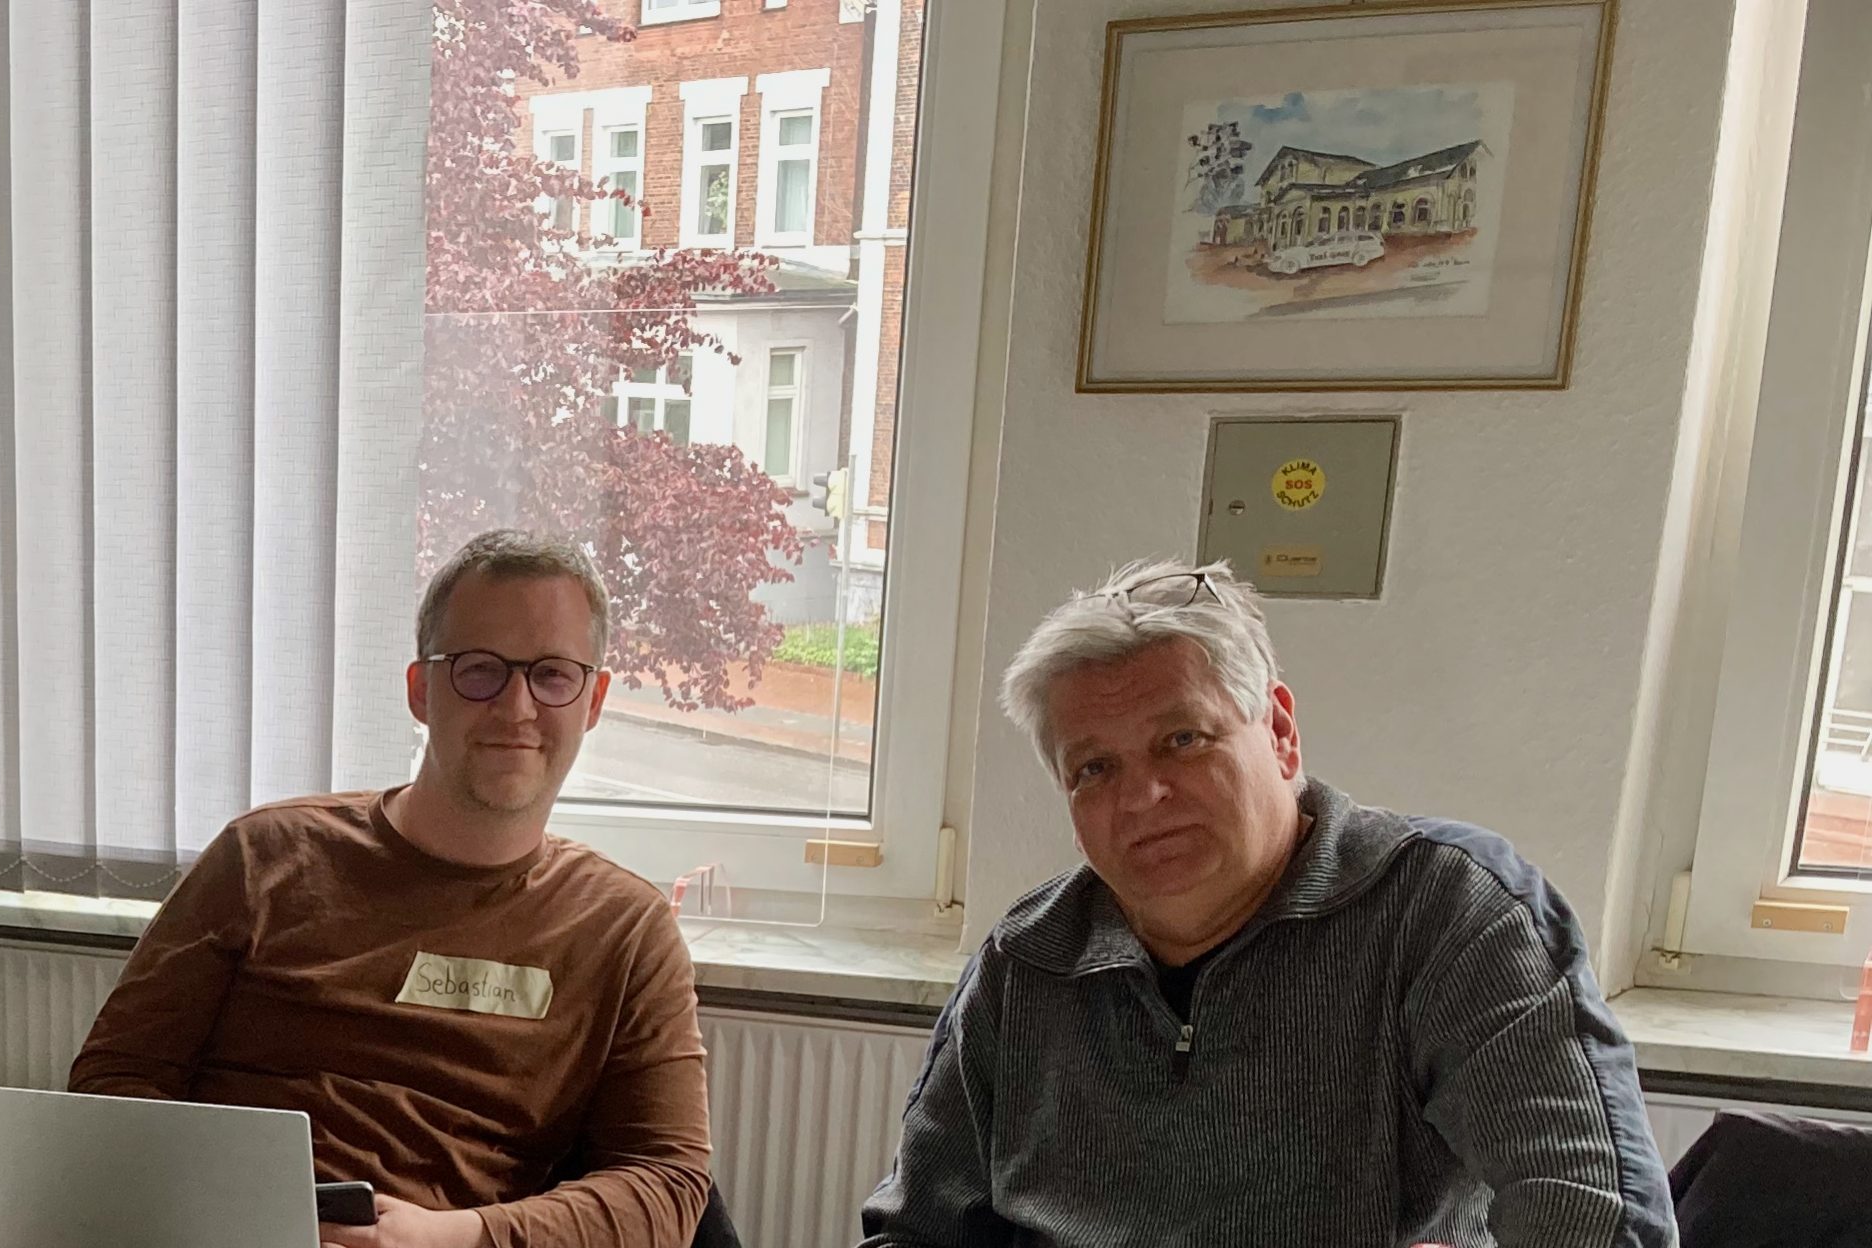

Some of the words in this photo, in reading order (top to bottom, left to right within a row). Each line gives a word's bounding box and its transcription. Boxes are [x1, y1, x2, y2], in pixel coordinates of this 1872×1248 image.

[1281, 461, 1317, 476] KLIMA
[1285, 479, 1313, 490] SOS
[1277, 490, 1320, 509] SCHUTZ
[415, 962, 516, 1002] Sebastian
